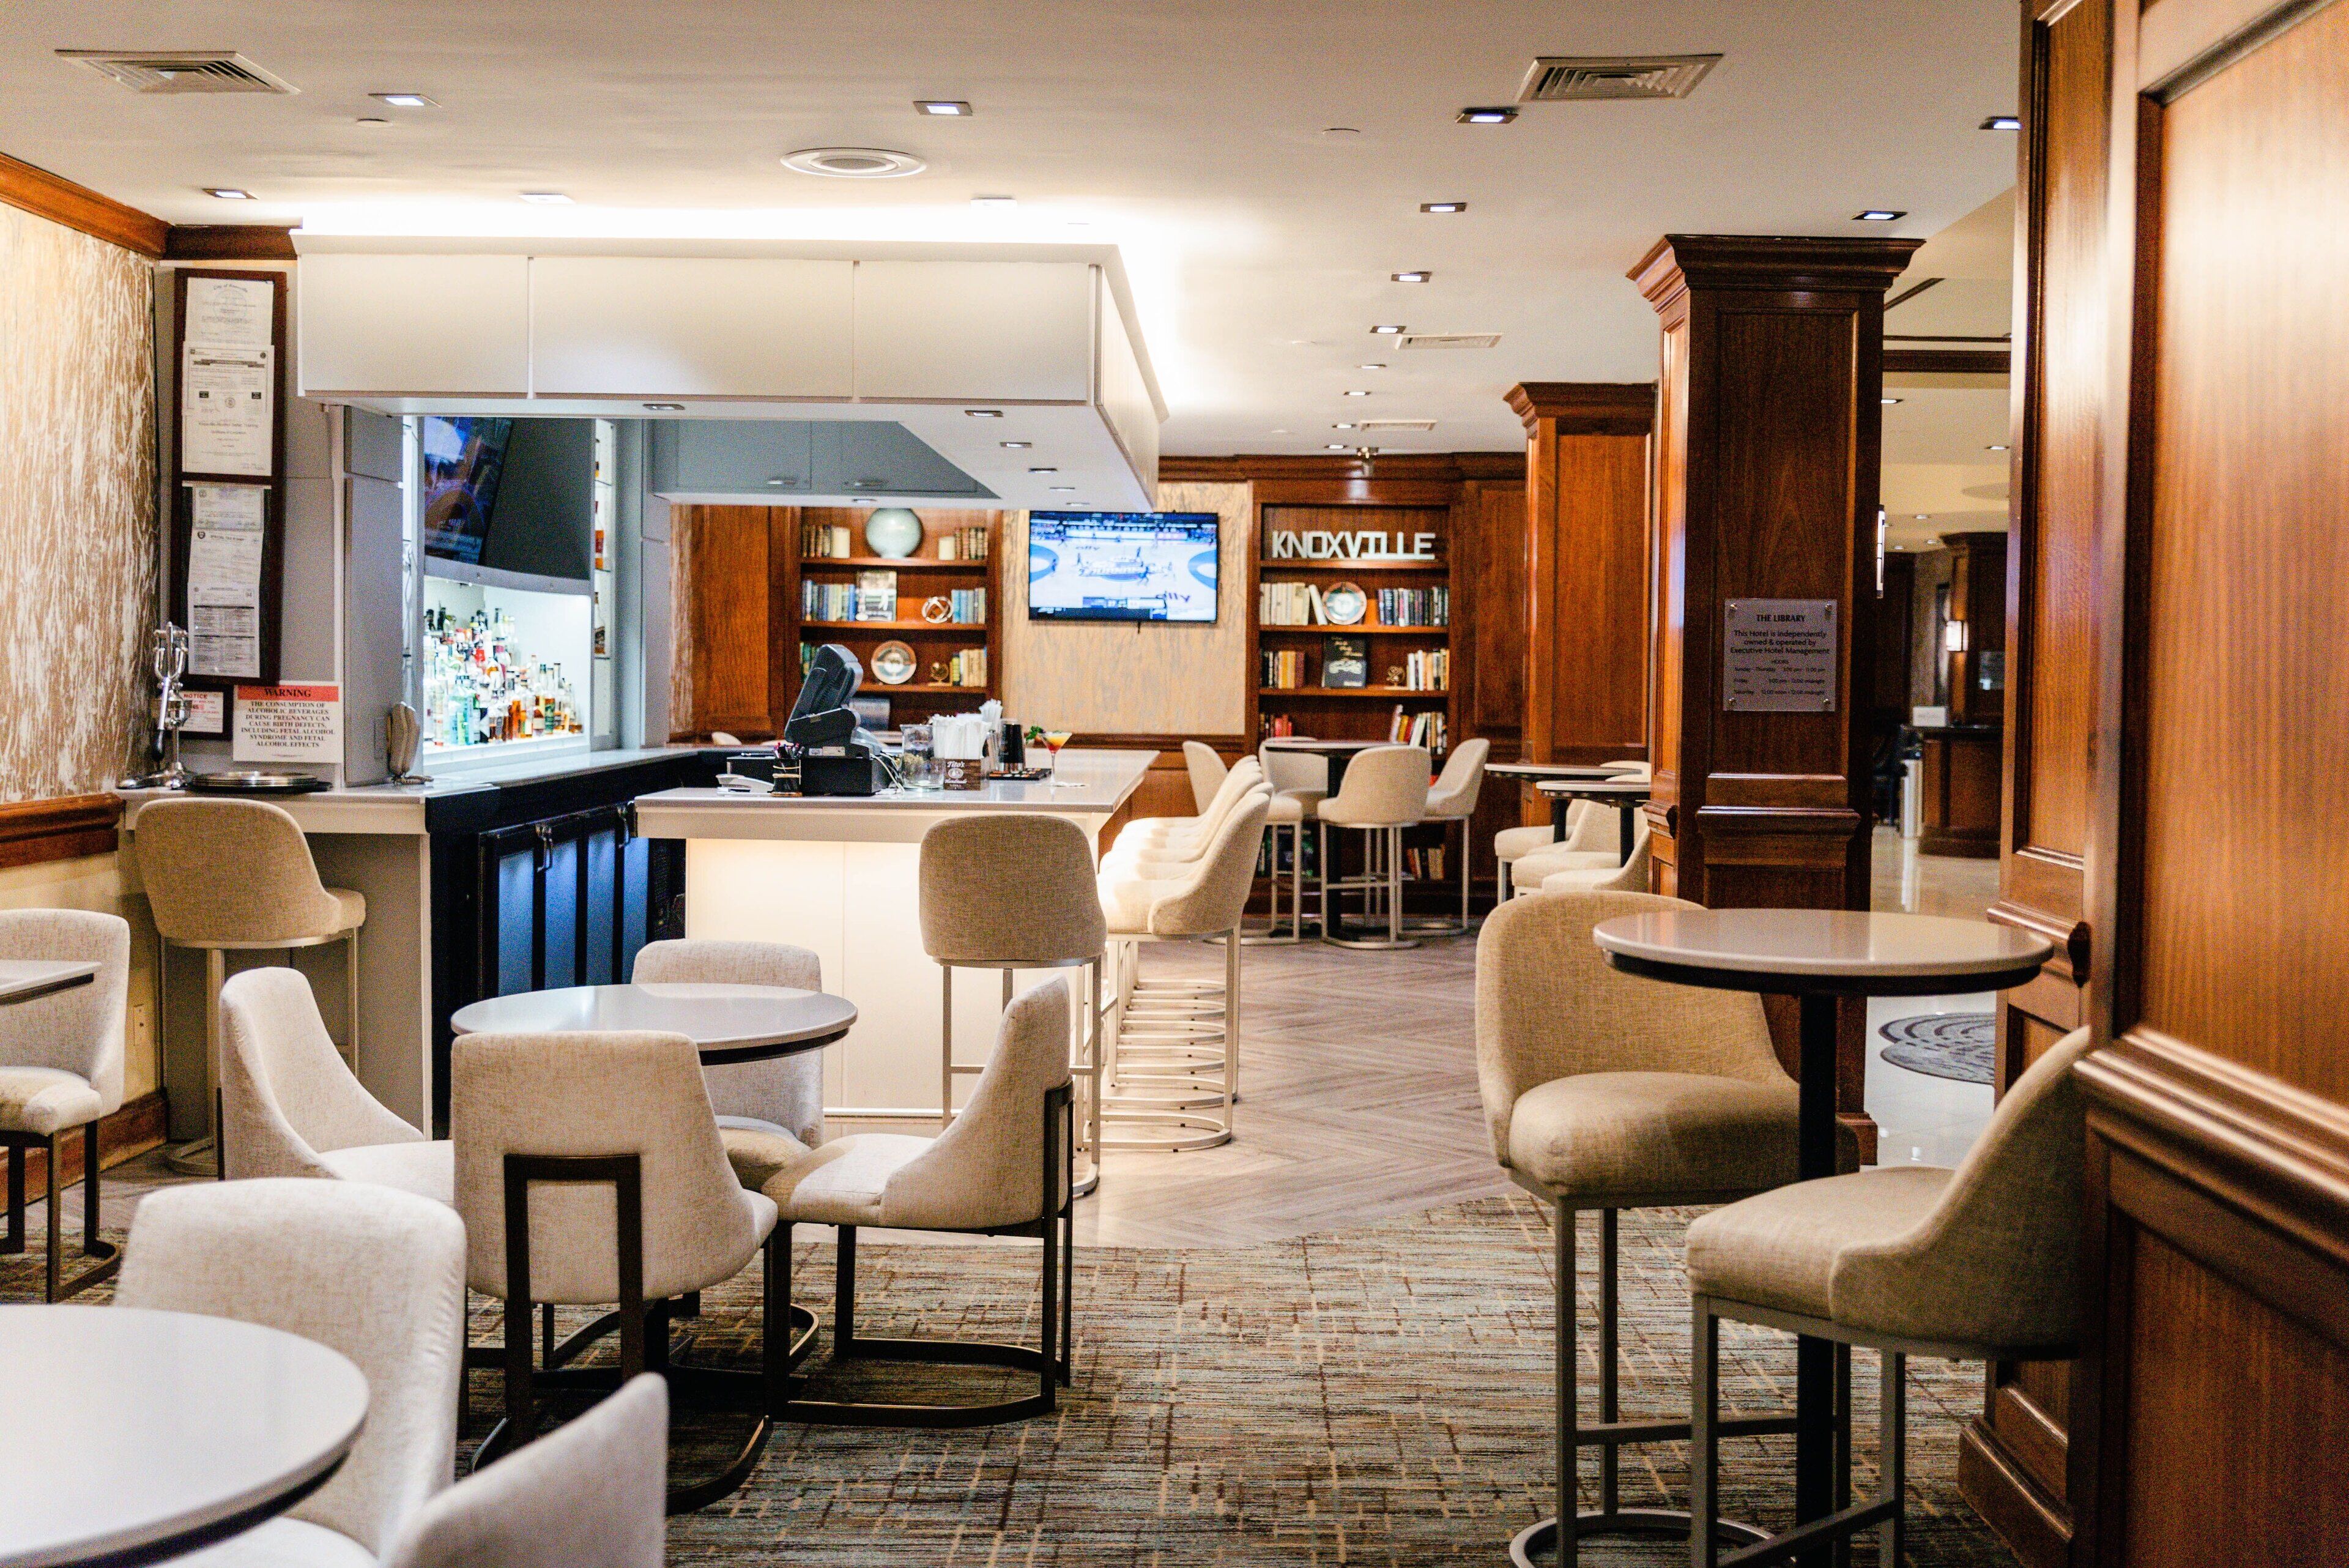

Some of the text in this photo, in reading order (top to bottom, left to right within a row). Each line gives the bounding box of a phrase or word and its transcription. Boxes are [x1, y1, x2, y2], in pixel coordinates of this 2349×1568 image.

[1272, 530, 1436, 560] KNOXVILLE
[1808, 639, 1817, 647] by
[1785, 647, 1830, 656] Management
[264, 688, 311, 697] WARNING
